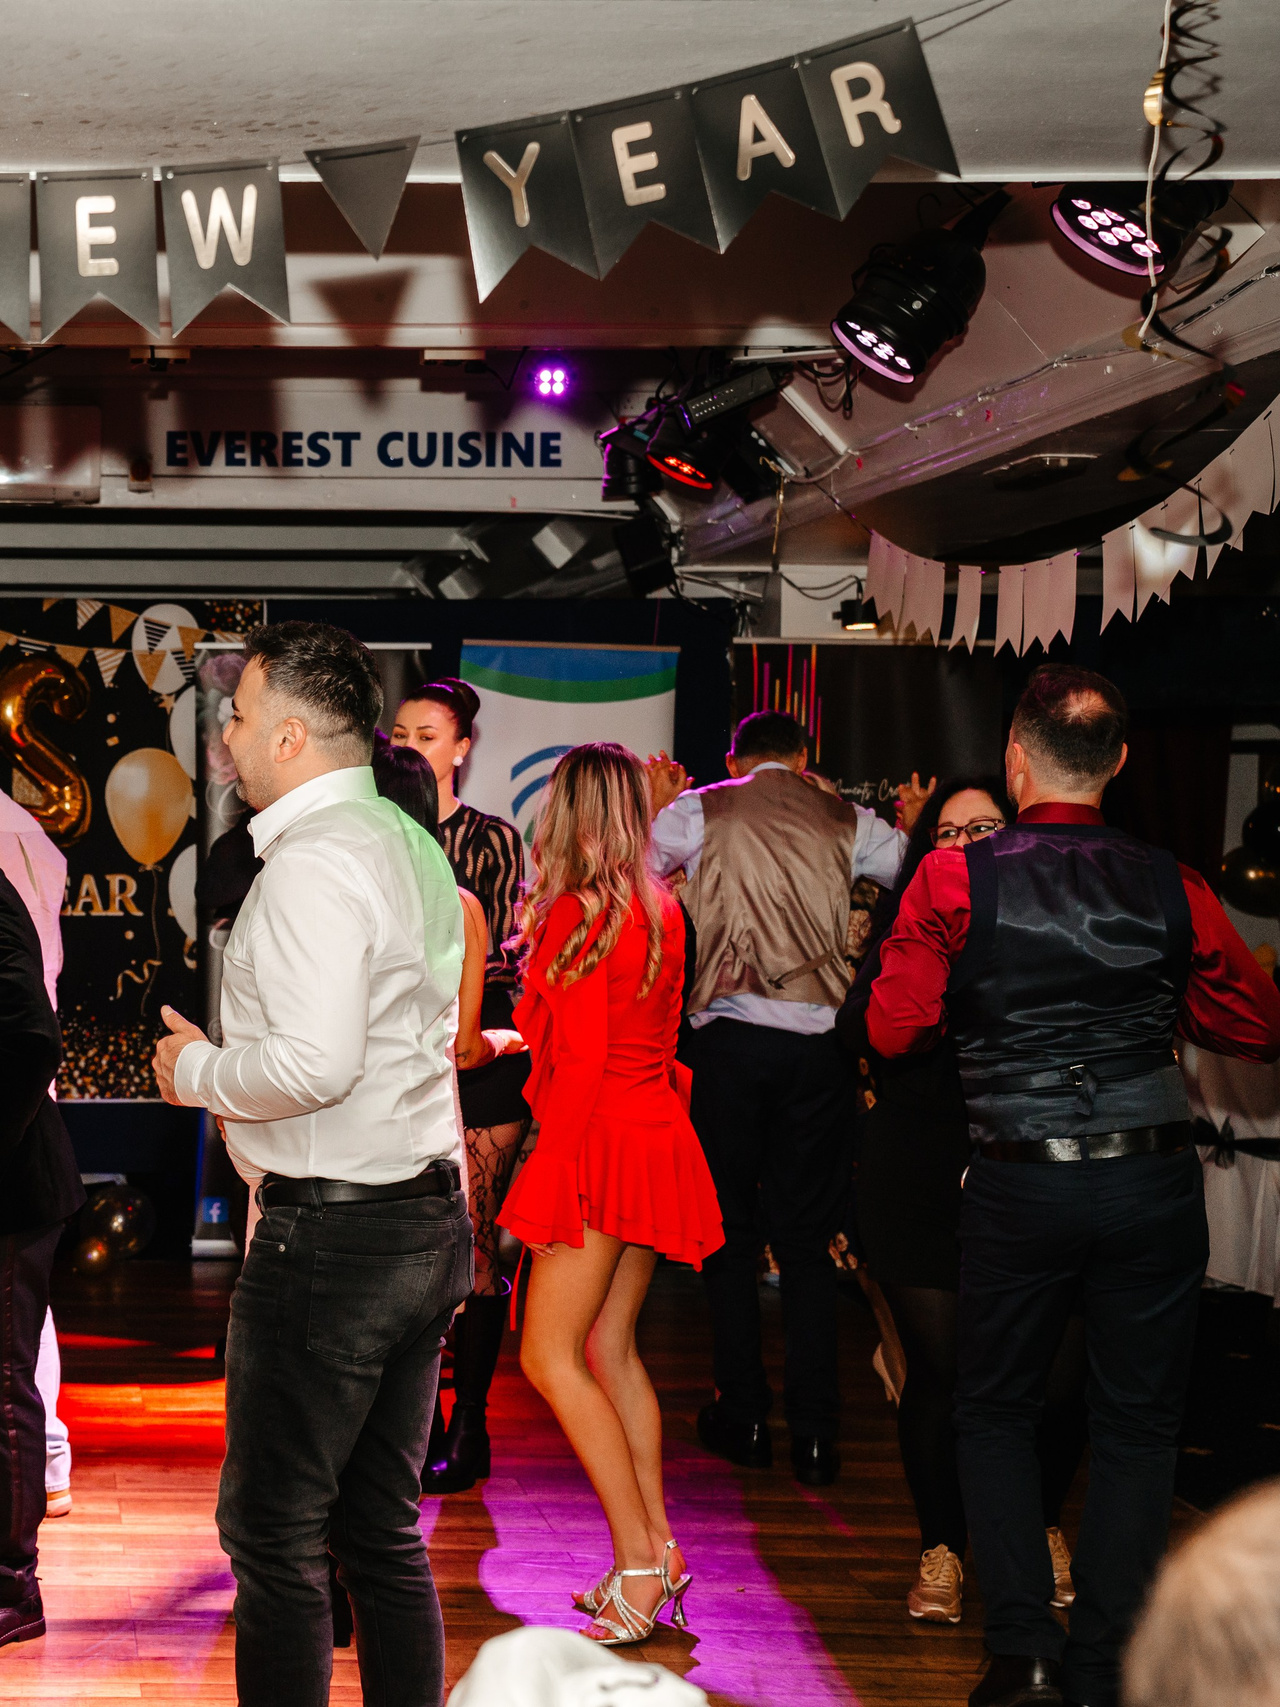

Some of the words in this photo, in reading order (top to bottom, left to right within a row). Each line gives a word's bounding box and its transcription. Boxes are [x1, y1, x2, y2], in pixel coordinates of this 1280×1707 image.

[482, 60, 902, 228] YEAR
[165, 430, 361, 468] EVEREST
[376, 430, 563, 469] CUISINE
